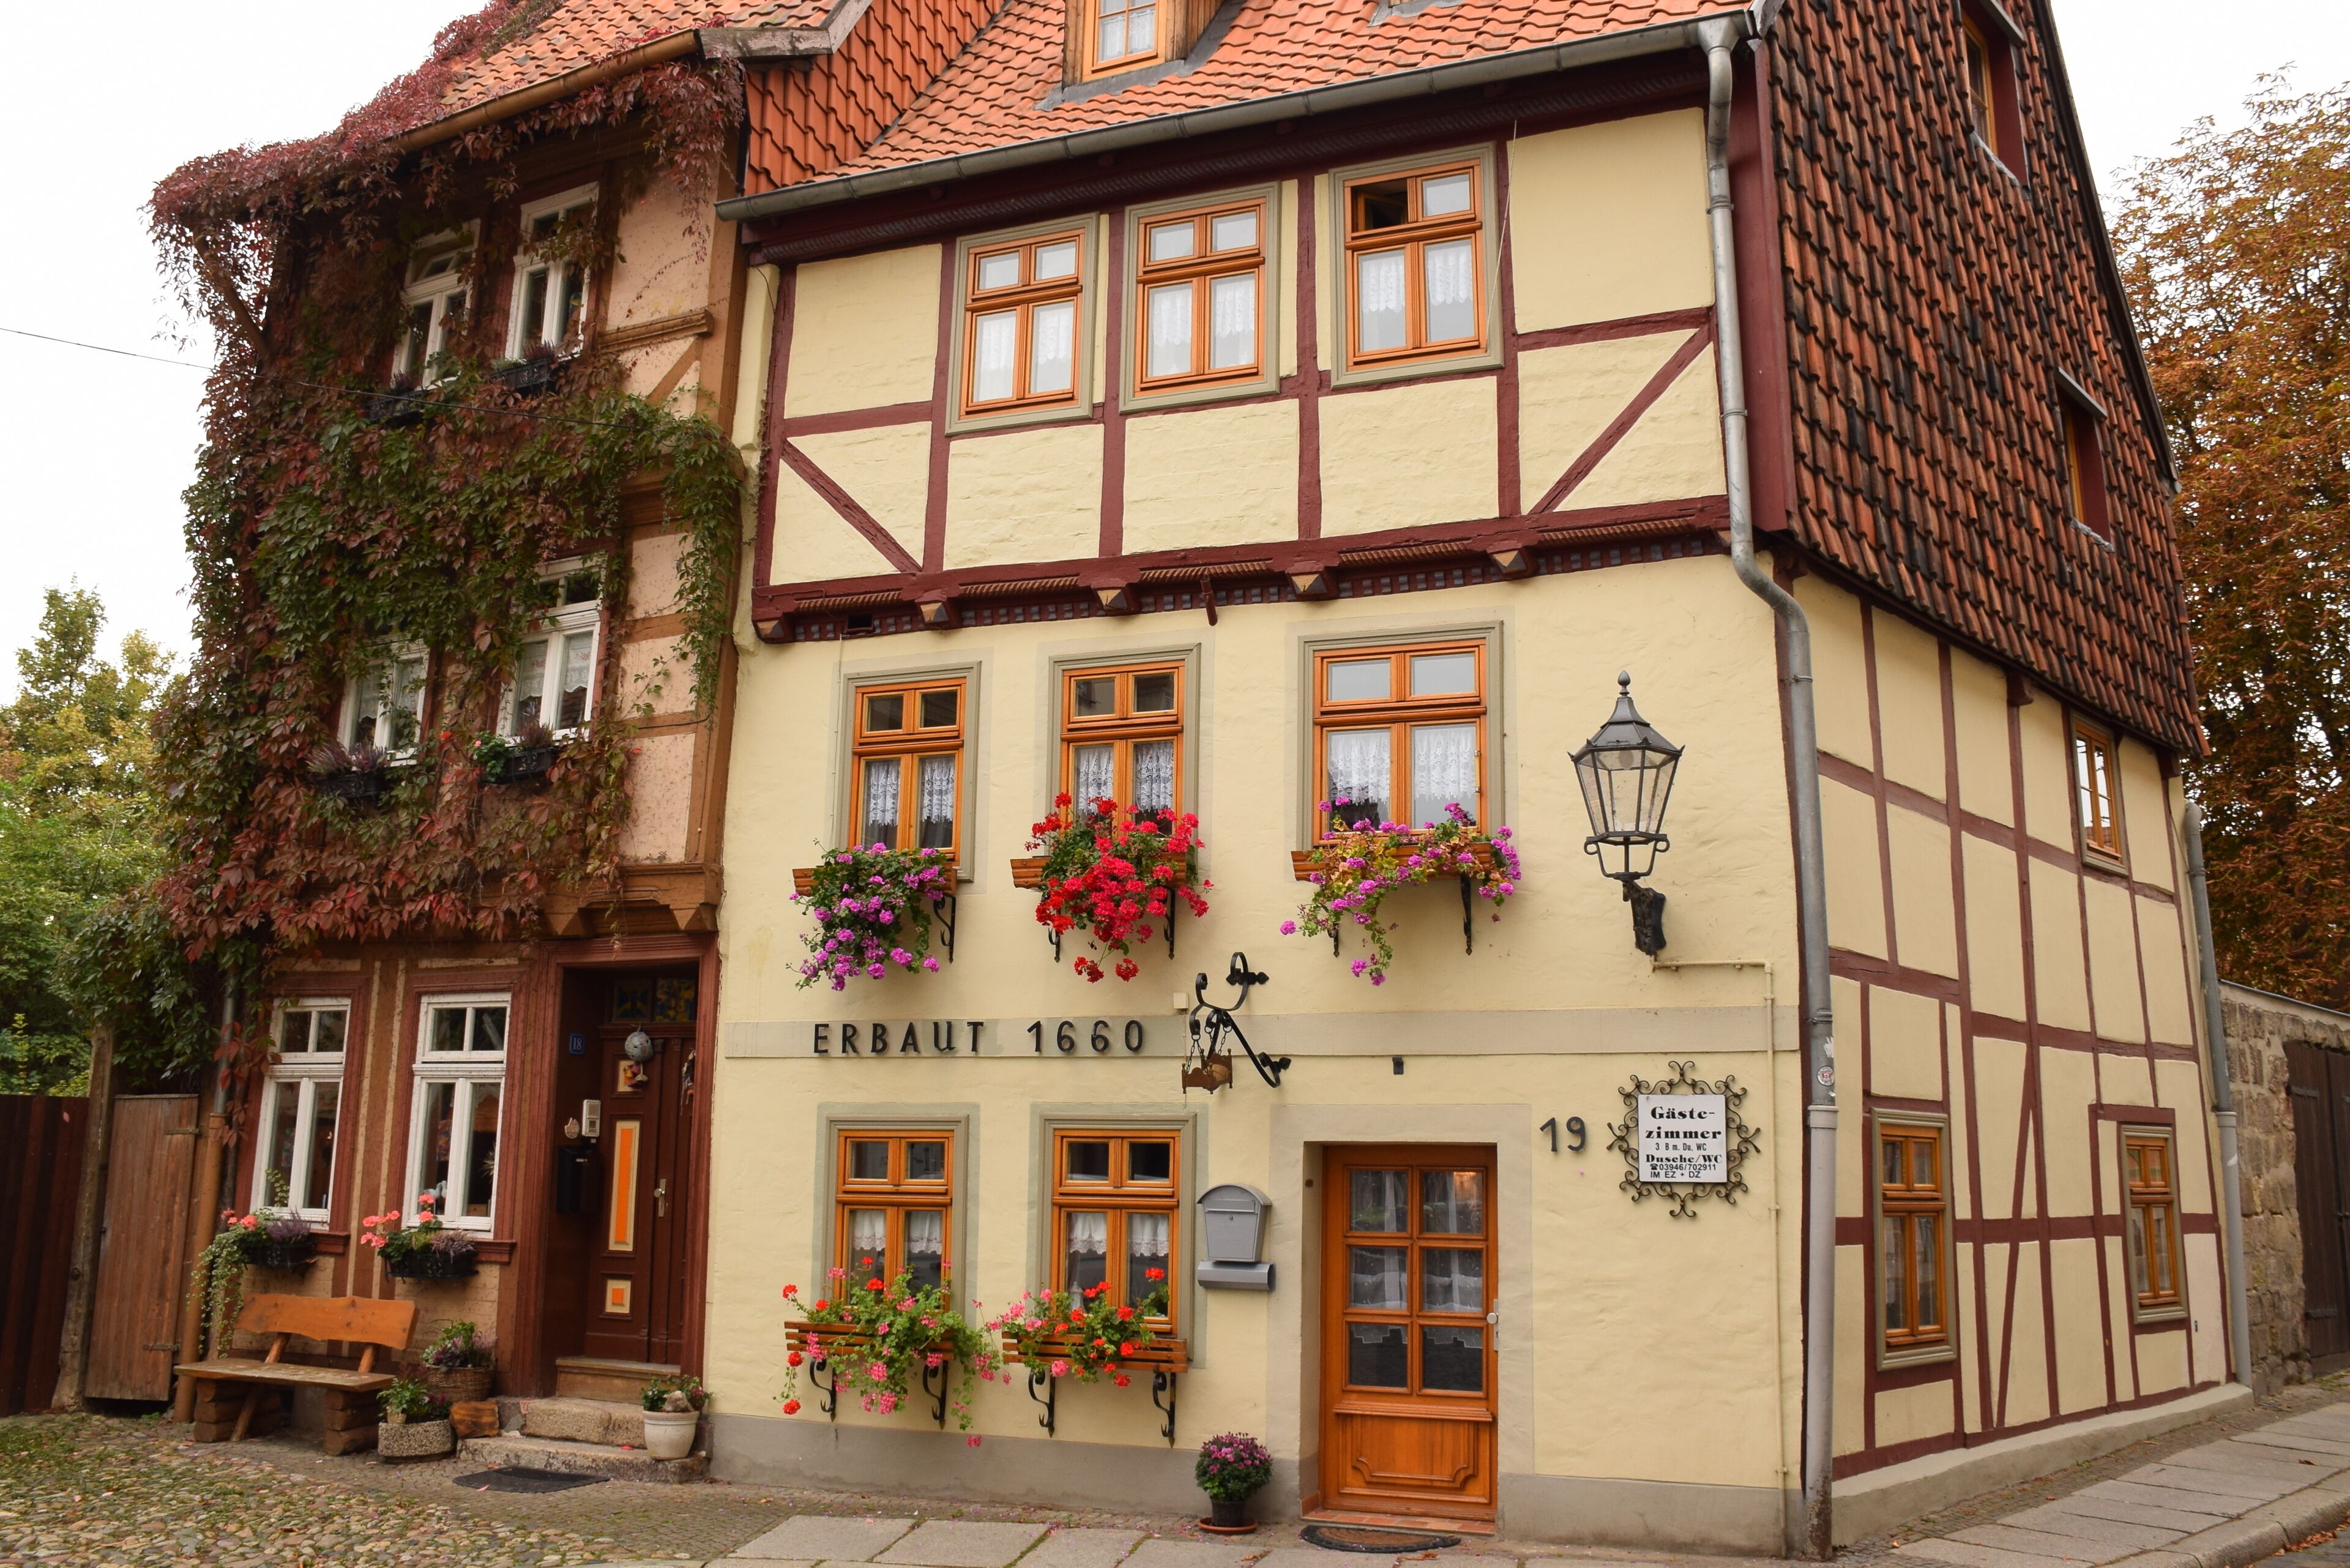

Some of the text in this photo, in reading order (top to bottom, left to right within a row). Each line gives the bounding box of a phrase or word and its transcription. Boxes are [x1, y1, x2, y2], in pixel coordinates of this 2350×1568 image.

[813, 1020, 1143, 1054] ERBAUT 1660
[573, 1037, 582, 1051] 18
[1651, 1106, 1715, 1119] Gäste-
[1539, 1116, 1586, 1152] 19
[1645, 1126, 1721, 1139] zimmer
[1682, 1143, 1693, 1151] Du.
[1696, 1143, 1707, 1151] WC
[1646, 1154, 1722, 1163] Dusche/WC
